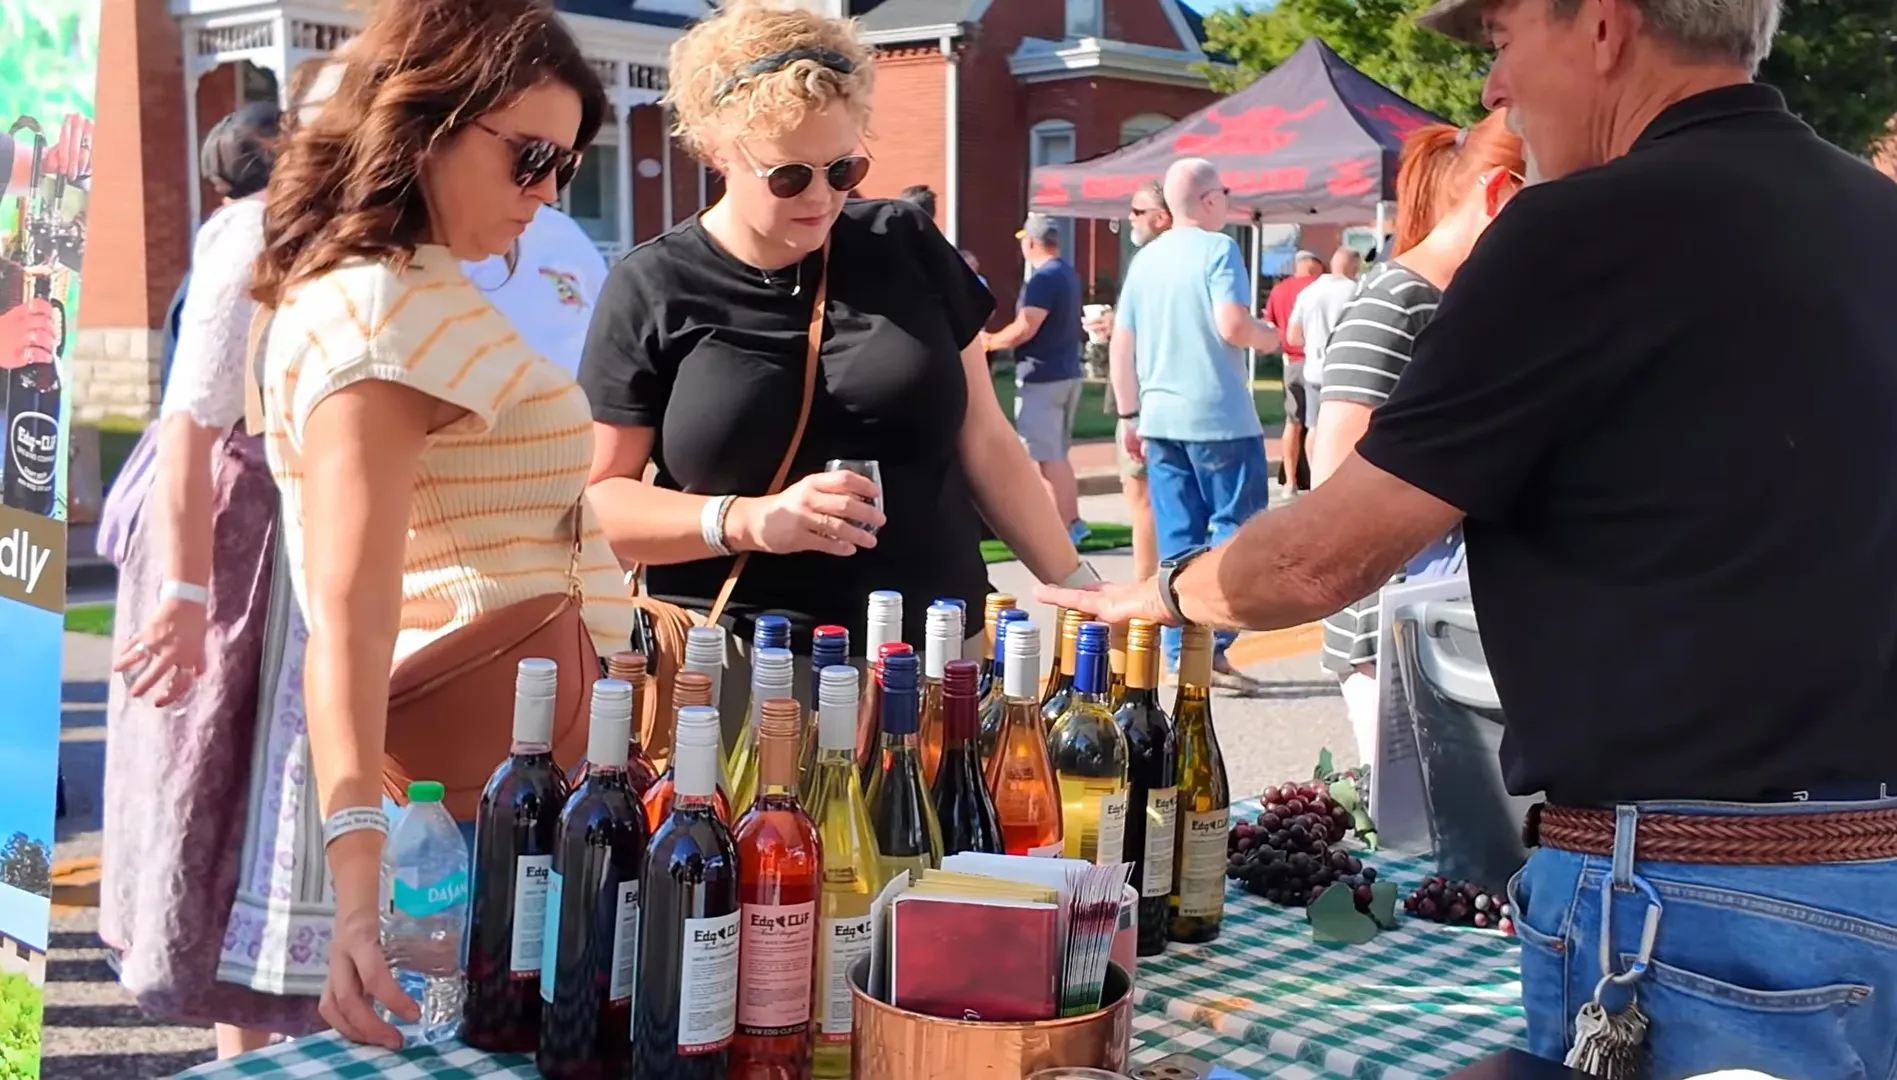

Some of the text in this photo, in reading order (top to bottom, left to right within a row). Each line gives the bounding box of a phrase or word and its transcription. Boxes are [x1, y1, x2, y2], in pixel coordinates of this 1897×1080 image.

[751, 913, 775, 931] Edg
[694, 929, 718, 945] Edg
[834, 924, 856, 938] Edg
